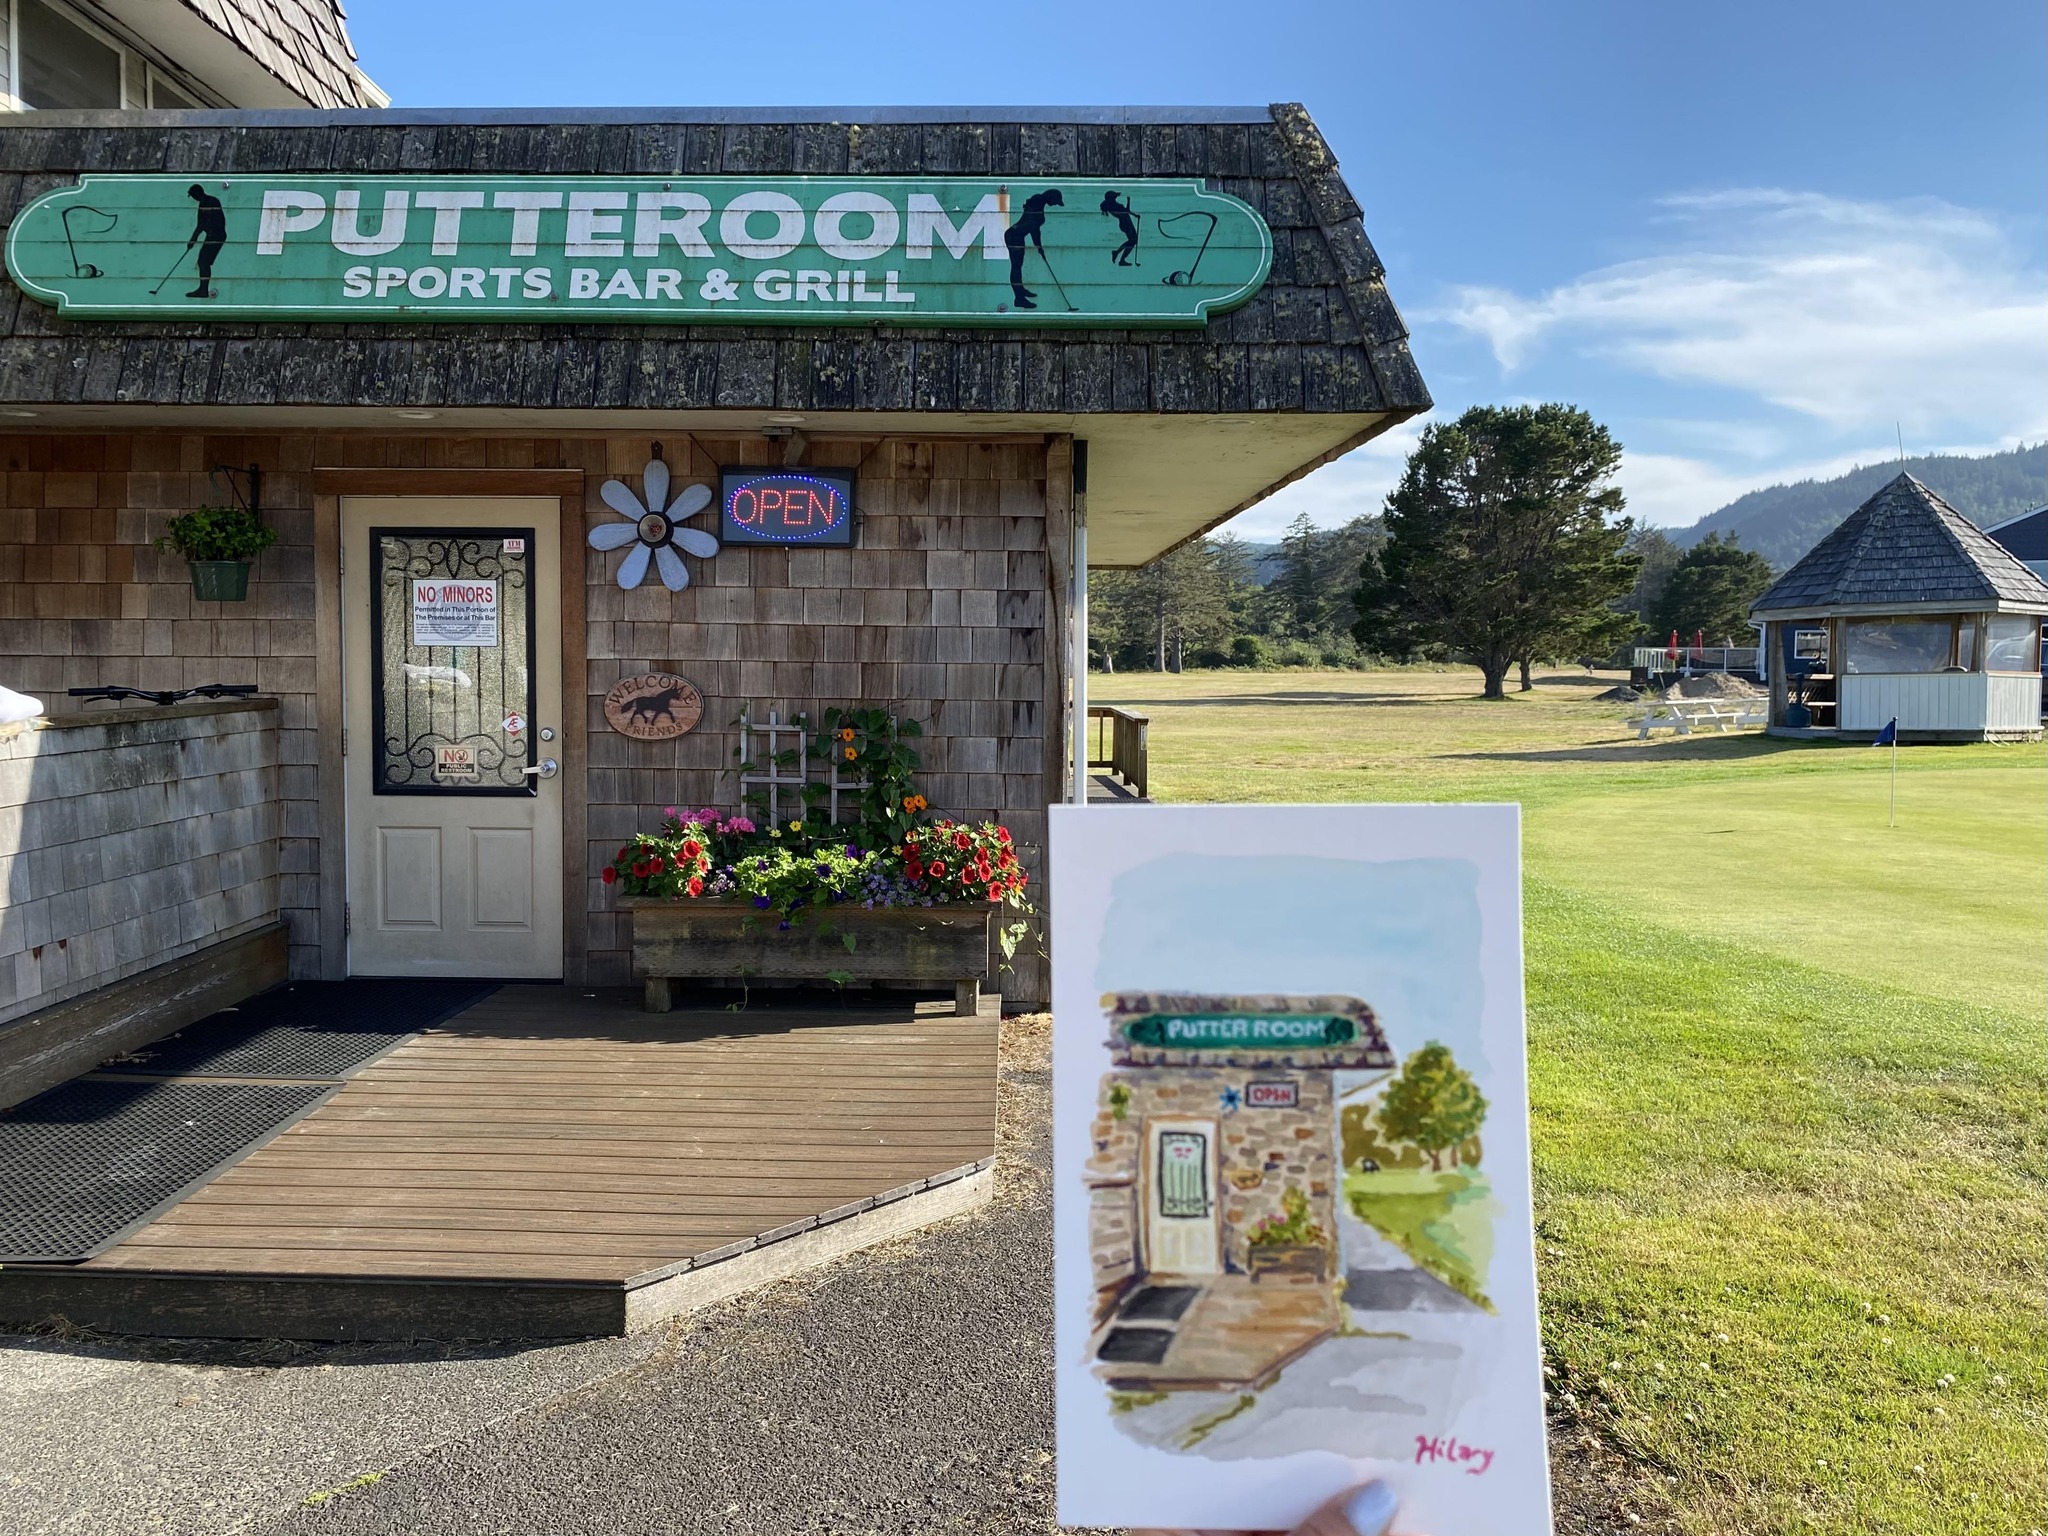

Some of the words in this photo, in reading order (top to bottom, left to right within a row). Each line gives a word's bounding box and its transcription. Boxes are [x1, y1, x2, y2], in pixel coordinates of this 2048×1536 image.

[256, 190, 1010, 260] PUTTEROOM
[342, 266, 552, 300] SPORTS
[568, 268, 684, 300] BAR
[700, 269, 740, 301] &
[752, 270, 916, 303] GRILL
[732, 488, 835, 525] OPEN
[417, 586, 436, 602] NO
[443, 586, 493, 602] MINORS
[609, 675, 697, 705] WELCOME
[625, 722, 683, 737] FRIENDS
[1167, 1019, 1249, 1039] PUTTER
[1253, 1020, 1326, 1038] ROOM
